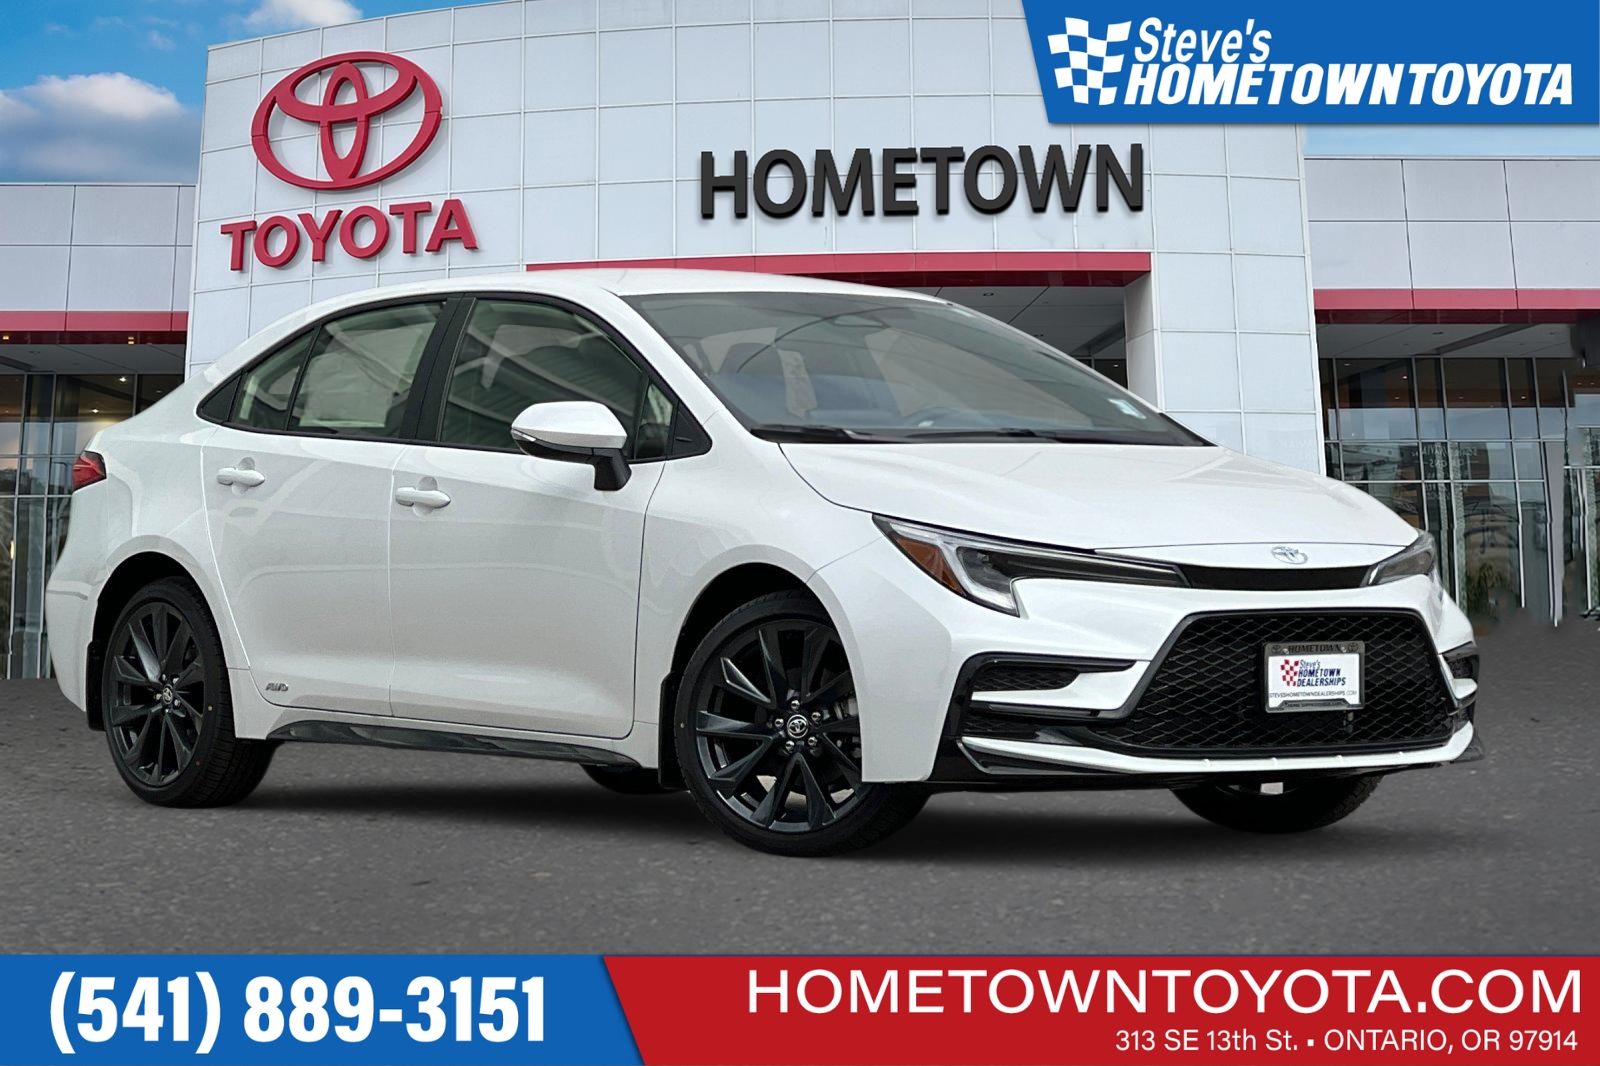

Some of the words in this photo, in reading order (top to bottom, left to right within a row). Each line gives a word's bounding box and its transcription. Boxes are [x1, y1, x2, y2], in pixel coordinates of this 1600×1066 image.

[700, 143, 1144, 219] HOMETOWN
[221, 199, 477, 270] TOYOTA
[1288, 644, 1340, 653] HOMETOWN
[1299, 659, 1320, 669] Steve's
[1298, 668, 1341, 678] HOMETOWN
[1296, 677, 1346, 687] DEALERSHIPS
[1268, 690, 1358, 698] STEVESHOMETOWNDEALERSHIPSCOM
